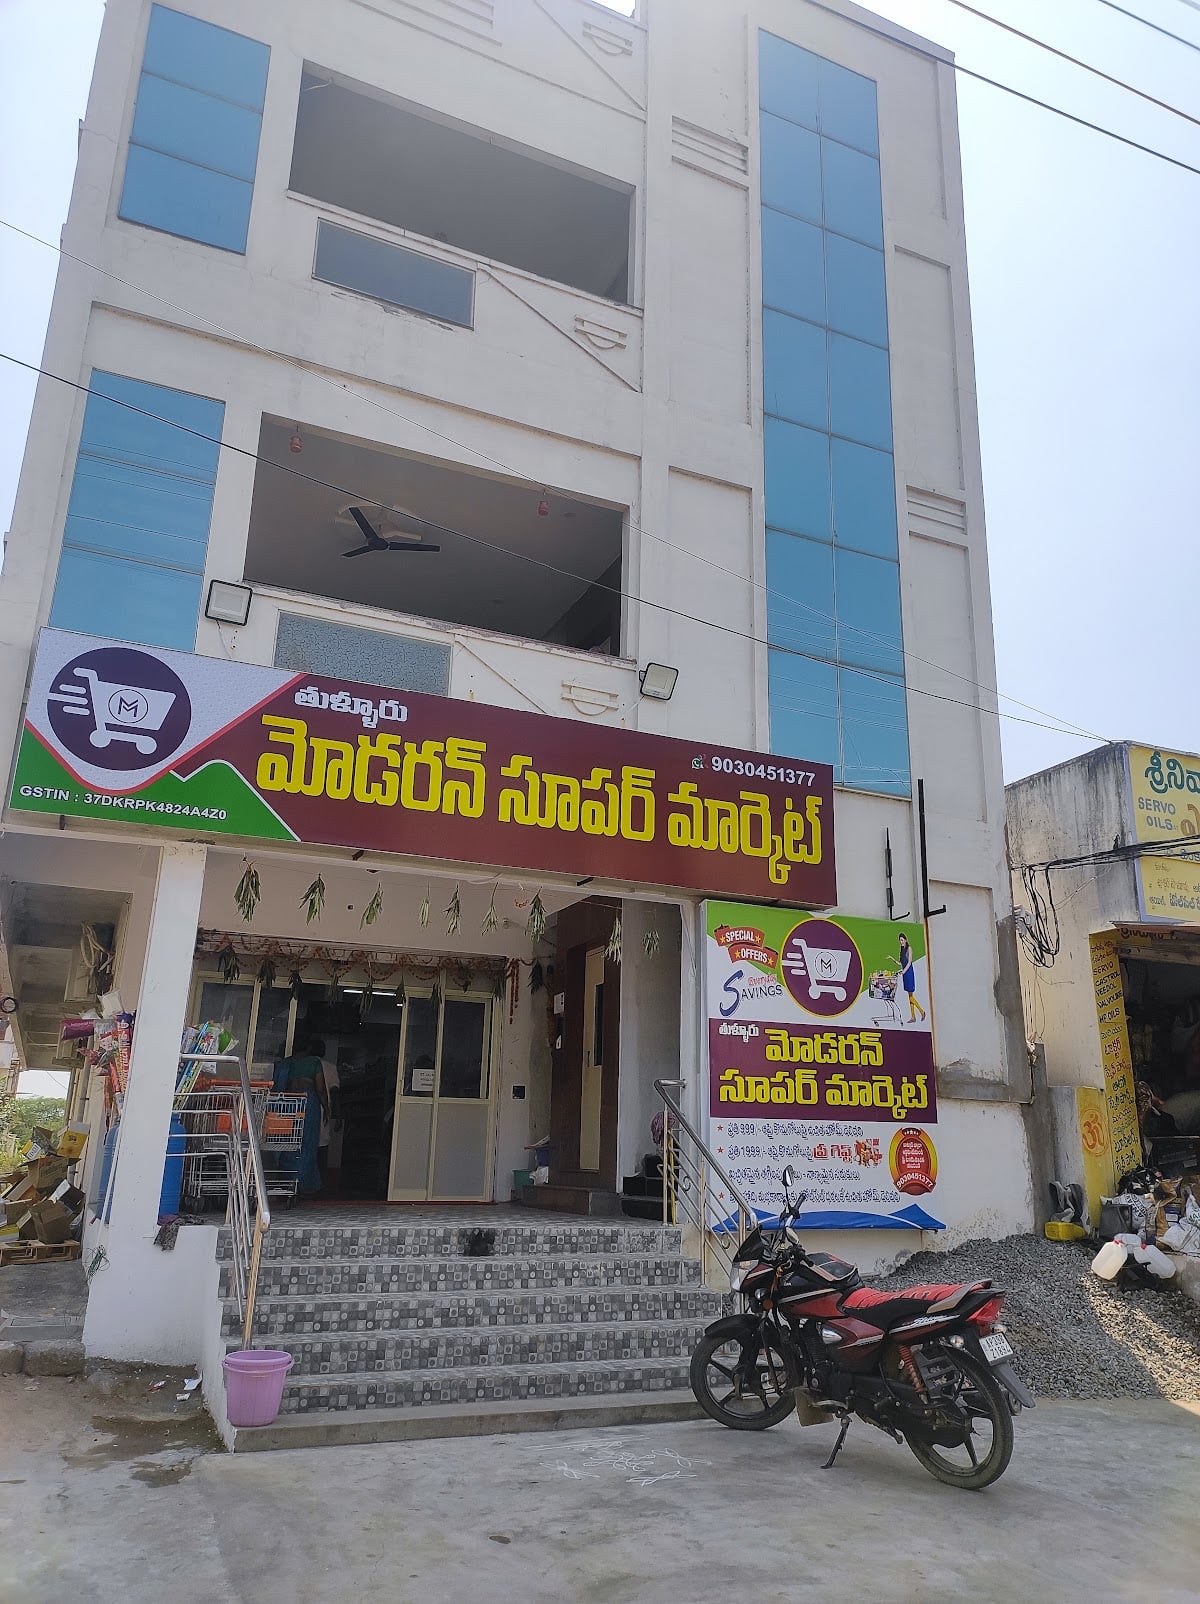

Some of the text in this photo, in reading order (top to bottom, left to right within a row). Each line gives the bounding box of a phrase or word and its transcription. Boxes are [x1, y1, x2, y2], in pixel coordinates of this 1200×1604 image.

[711, 755, 816, 787] 9030451377
[19, 785, 70, 802] GSTIN
[256, 714, 823, 885] మోడరన్ సూపర్ మార్కెట్
[1137, 797, 1176, 815] SERVO
[1146, 815, 1172, 831] OILS
[725, 929, 755, 943] SPECIAL
[740, 947, 768, 964] OFFERS
[1093, 961, 1114, 976] SERVO
[1095, 970, 1121, 987] CASTROL
[719, 969, 783, 1017] SAVINGS
[764, 1028, 884, 1067] మోడరన్
[719, 1068, 929, 1120] సూపర్ మార్కెట్
[896, 1172, 934, 1188] 9030451377
